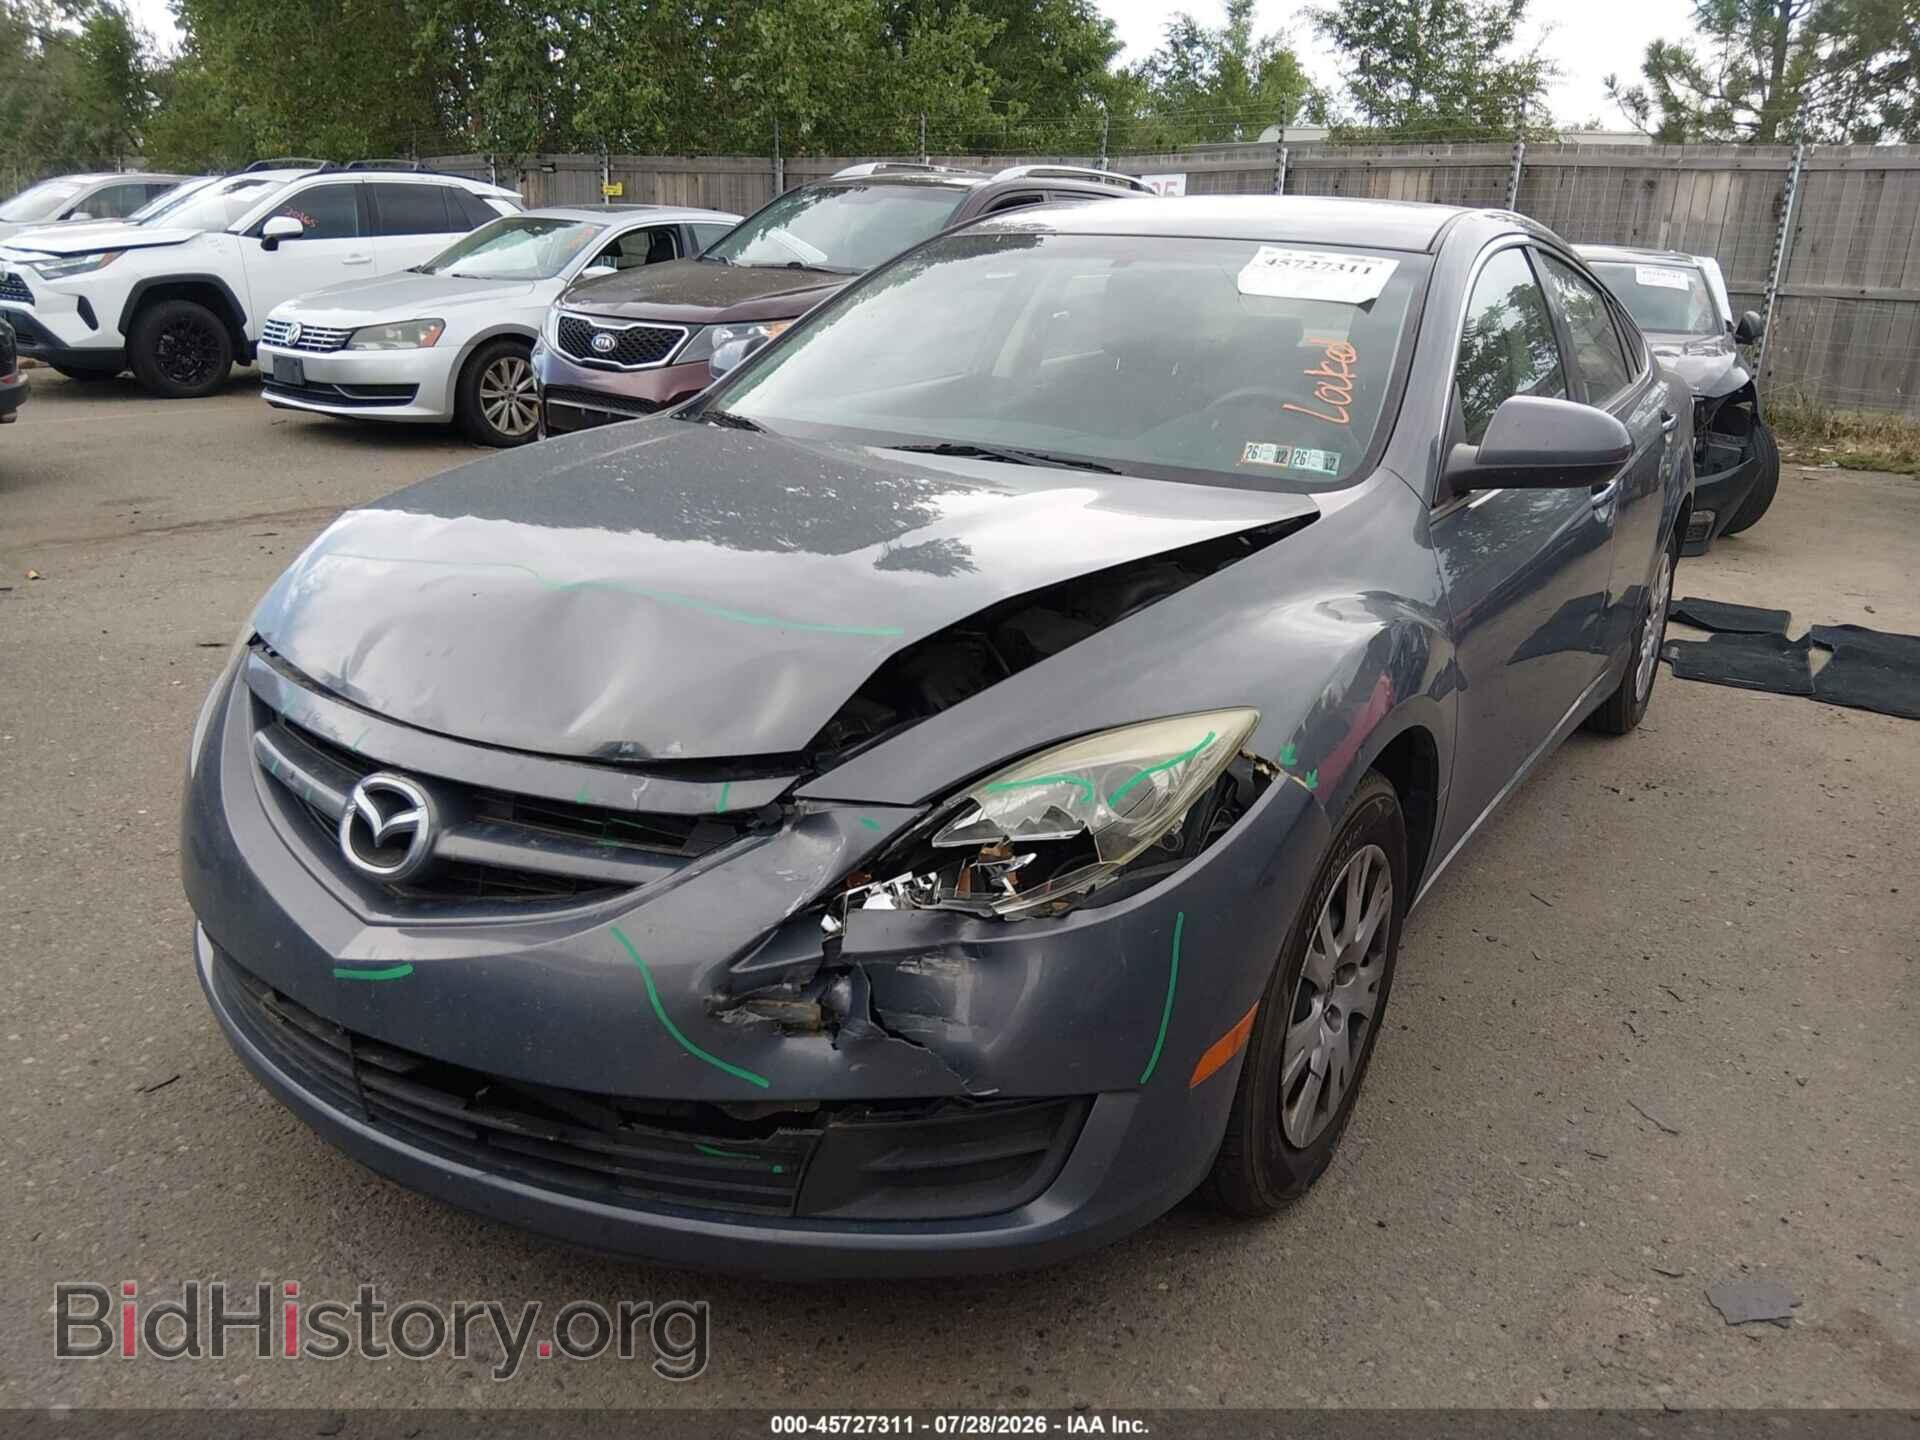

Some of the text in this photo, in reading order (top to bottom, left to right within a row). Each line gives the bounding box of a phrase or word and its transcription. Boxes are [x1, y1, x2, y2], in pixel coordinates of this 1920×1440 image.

[1264, 257, 1372, 274] 45727311
[1247, 445, 1260, 460] 26
[1294, 450, 1307, 466] 26
